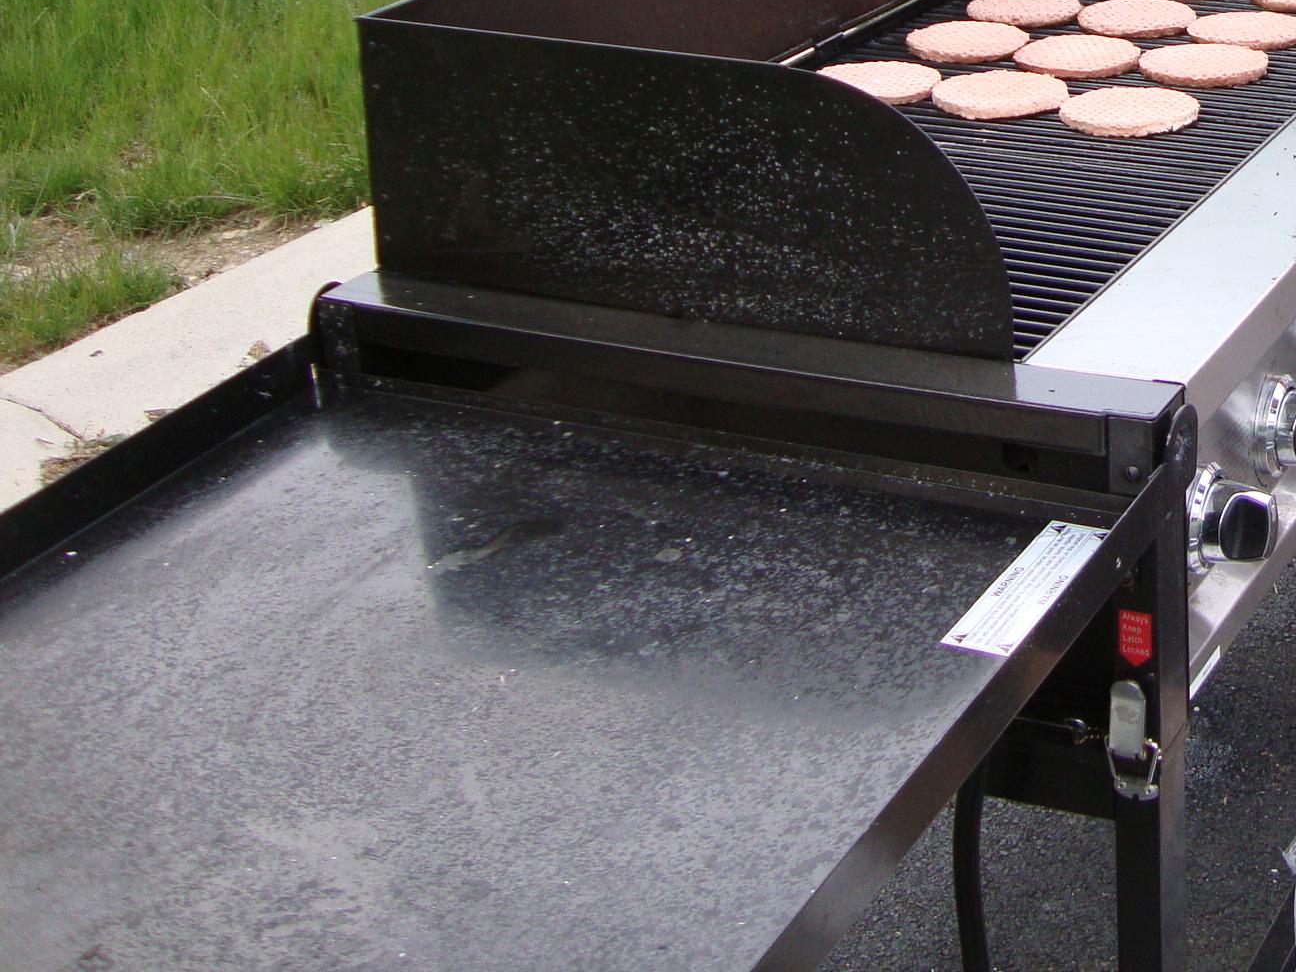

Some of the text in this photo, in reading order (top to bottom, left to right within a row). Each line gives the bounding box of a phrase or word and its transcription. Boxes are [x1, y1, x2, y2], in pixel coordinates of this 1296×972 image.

[991, 566, 1024, 597] WARNING
[1037, 574, 1069, 605] WARNING
[1122, 612, 1149, 625] Always
[1122, 623, 1142, 635] Keep
[1122, 634, 1143, 645] Latch
[1122, 645, 1150, 657] Locked
